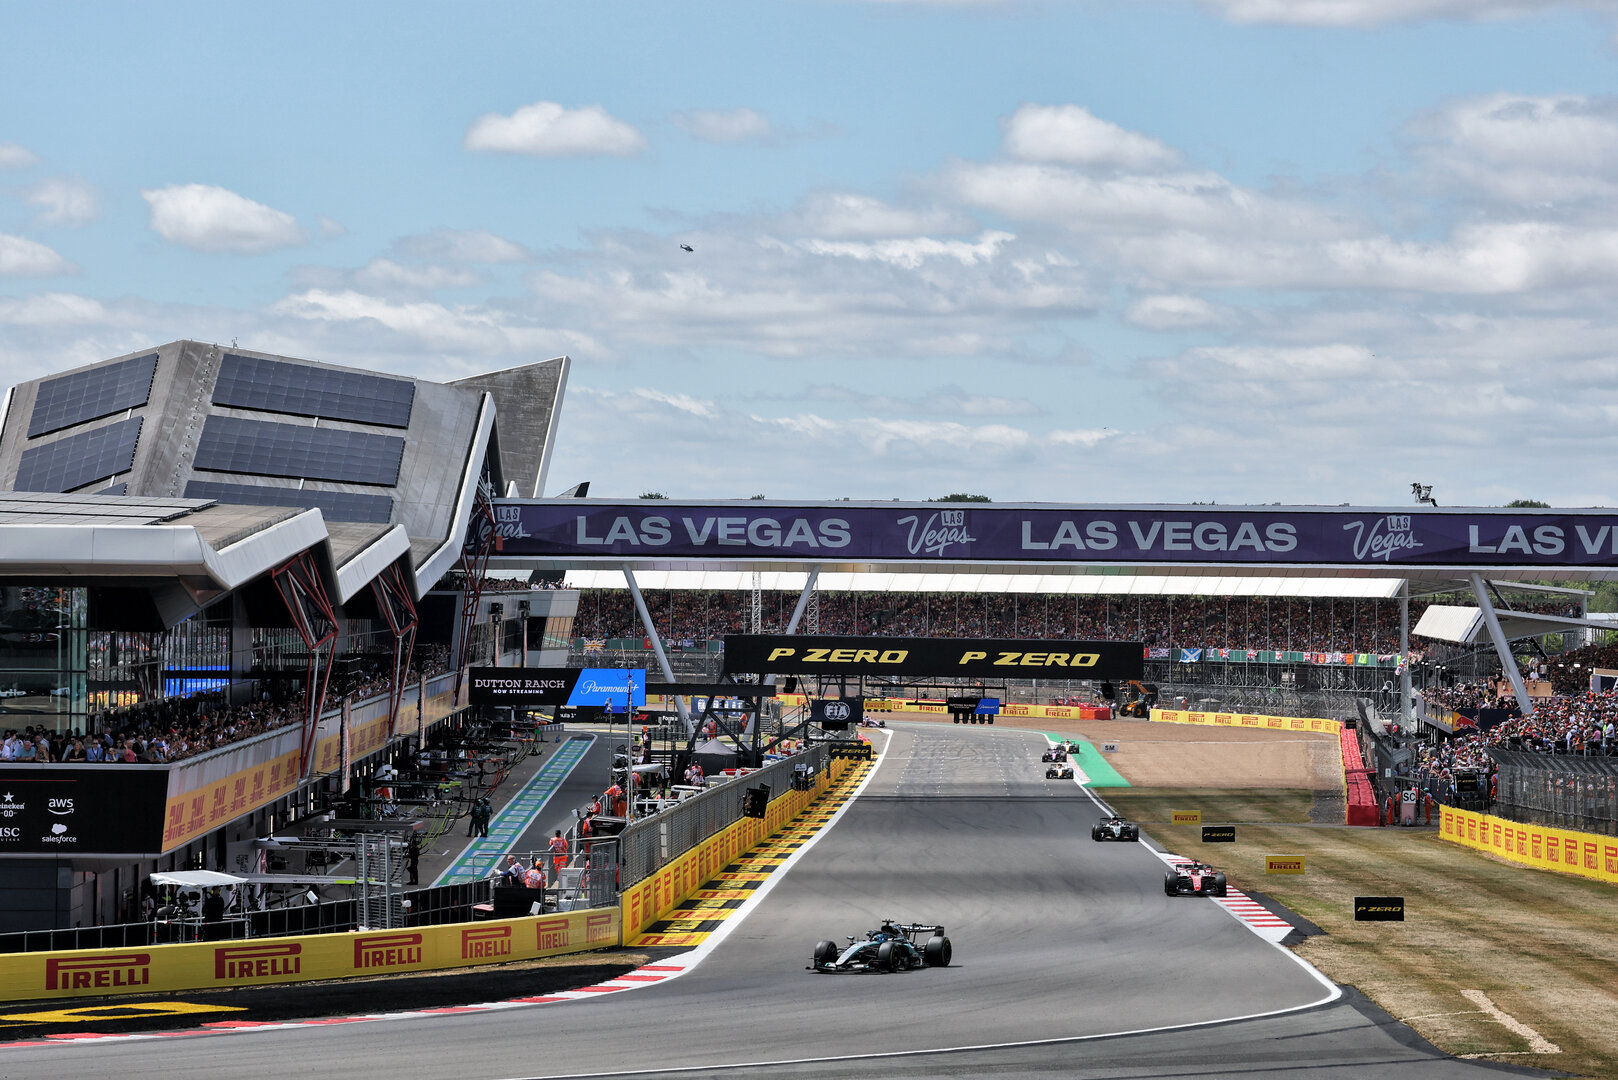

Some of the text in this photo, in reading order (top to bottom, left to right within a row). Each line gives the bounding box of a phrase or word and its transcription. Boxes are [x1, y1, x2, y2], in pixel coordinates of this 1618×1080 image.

[497, 507, 520, 521] LAS
[942, 511, 963, 526] LAS
[577, 516, 851, 547] LAS VEGAS
[1387, 516, 1410, 531] LAS
[897, 513, 976, 557] Vegas
[1022, 521, 1297, 552] LAS VEGAS
[1343, 518, 1424, 562] Vegas
[1469, 525, 1565, 555] LAS
[767, 648, 909, 664] P ZERO
[959, 651, 1101, 667] P ZERO
[474, 679, 566, 689] DUTTON RANCH
[826, 704, 848, 716] FIA
[1003, 706, 1029, 715] PIRELLI
[1045, 708, 1072, 717] PIRELLI
[48, 799, 74, 808] aws
[1403, 792, 1416, 802] SC
[0, 827, 20, 838] SC
[41, 835, 77, 843] salesforce
[1269, 861, 1301, 869] PIRELLI
[536, 919, 569, 950] PIRELLI
[586, 914, 611, 943] PIRELLI
[354, 933, 422, 968] PIRELLI
[461, 926, 512, 960] PIRELLI
[215, 943, 302, 979] PIRELLI
[46, 954, 150, 990] PIRELLI
